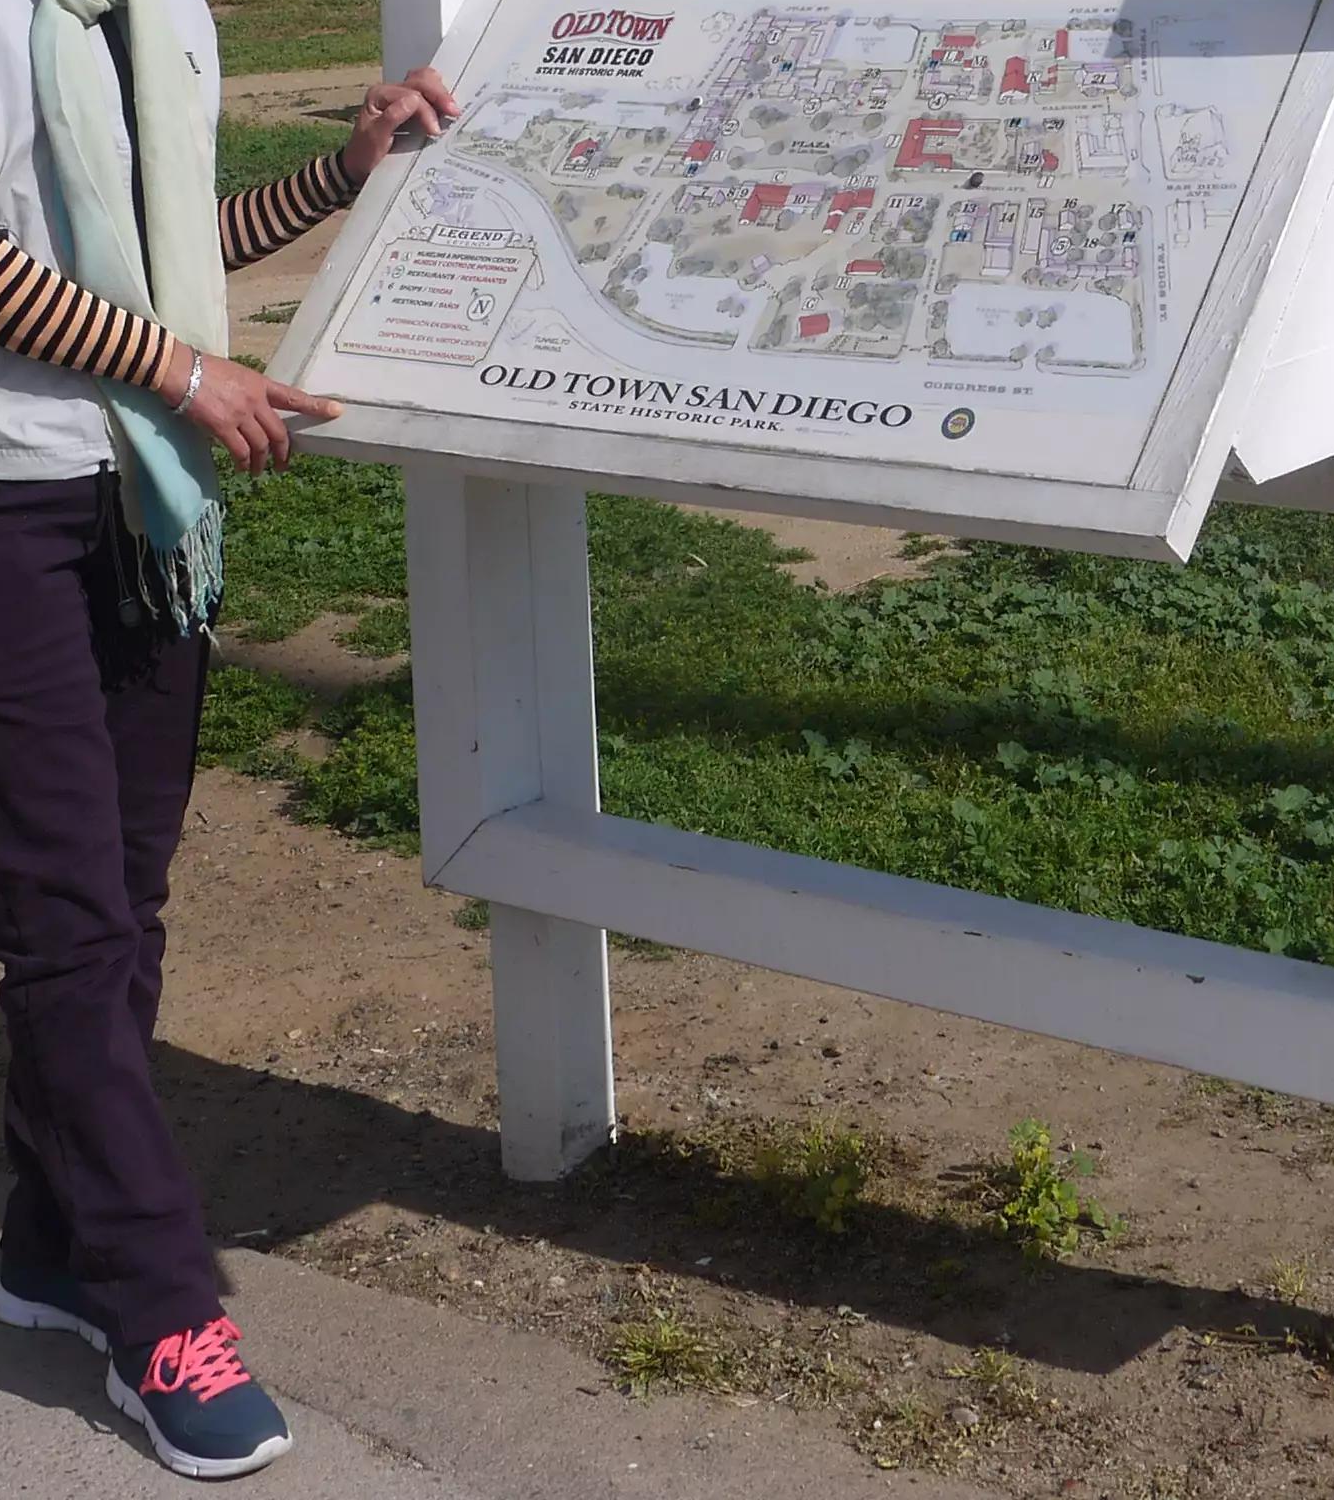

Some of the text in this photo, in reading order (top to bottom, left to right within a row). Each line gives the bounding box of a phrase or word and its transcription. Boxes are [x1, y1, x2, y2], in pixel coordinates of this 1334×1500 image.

[551, 9, 675, 40] OLD TOWN
[543, 47, 654, 66] SAN DIEGO
[535, 66, 564, 76] STATE
[567, 67, 613, 77] HISTORIC
[1090, 74, 1107, 84] 21
[740, 189, 749, 197] 9
[889, 198, 902, 208] 11
[907, 197, 922, 207] 12
[1063, 199, 1076, 208] 16
[961, 204, 976, 213] 13
[1029, 208, 1043, 217] 15
[1110, 204, 1124, 213] 17
[999, 213, 1014, 222] 14
[438, 228, 503, 240] LEGEND
[1083, 238, 1098, 247] 18
[472, 300, 490, 314] N
[924, 381, 1006, 393] CONGRESS
[479, 365, 911, 427] OLD TOWN SAN DIEGO
[569, 400, 625, 415] STATE
[627, 406, 726, 426] HISTORIC
